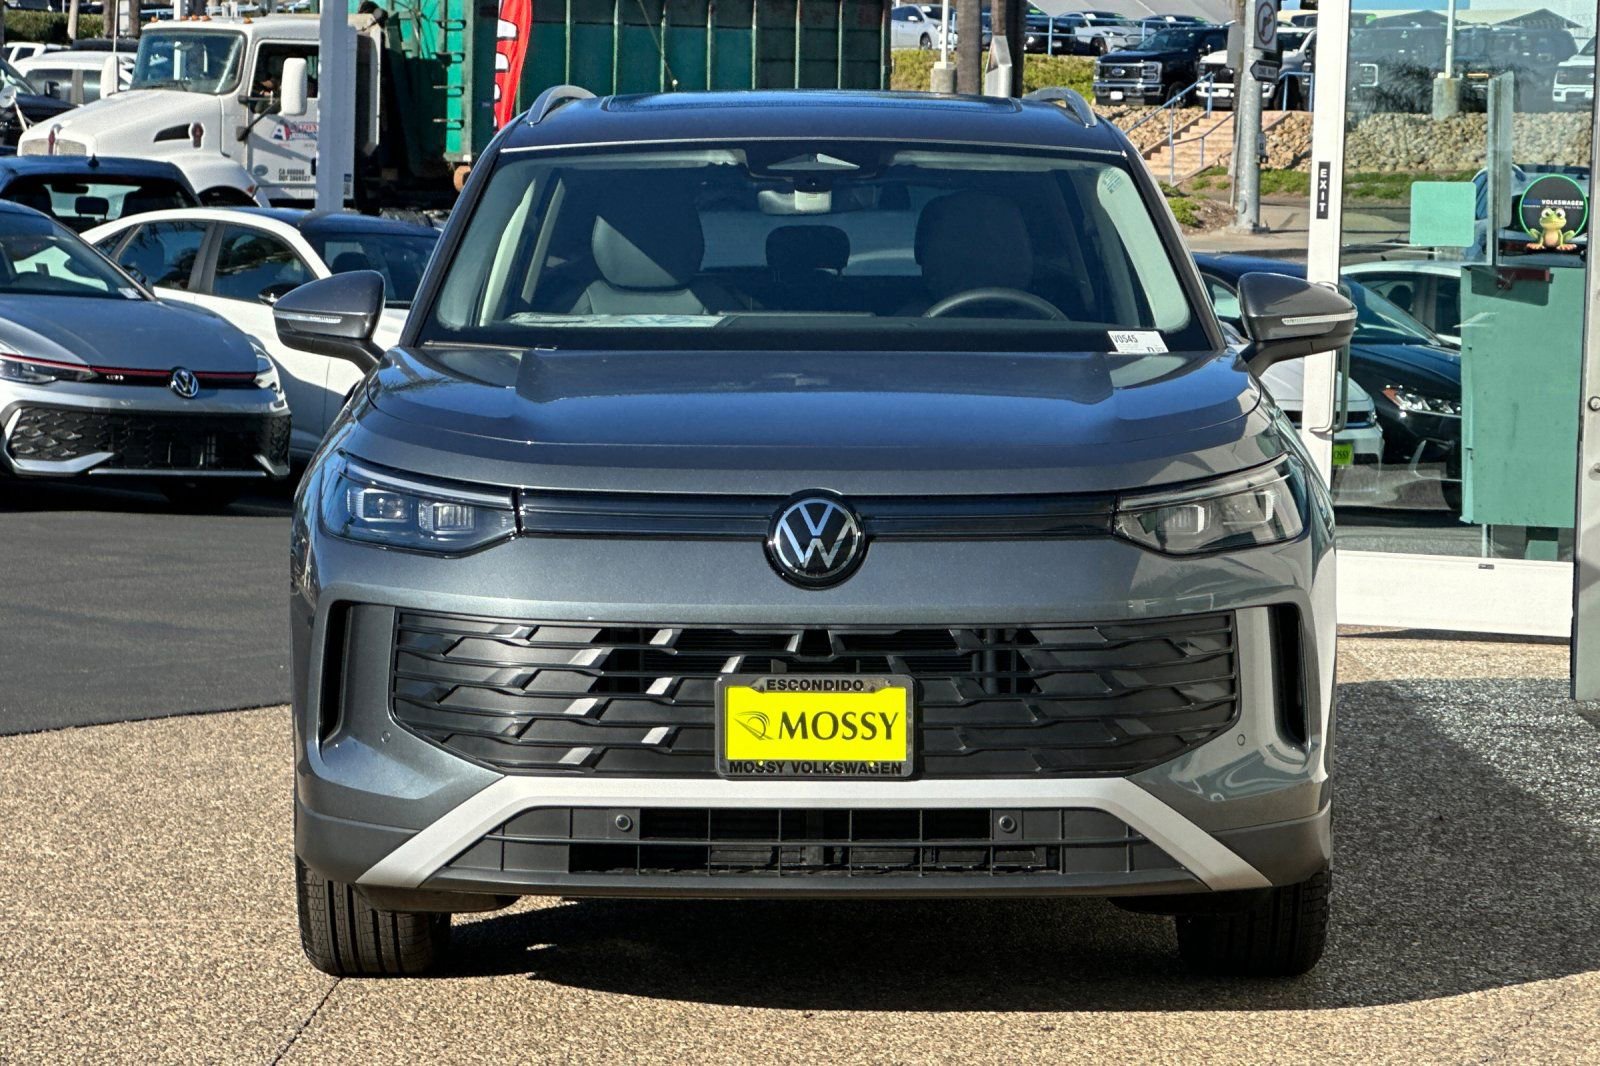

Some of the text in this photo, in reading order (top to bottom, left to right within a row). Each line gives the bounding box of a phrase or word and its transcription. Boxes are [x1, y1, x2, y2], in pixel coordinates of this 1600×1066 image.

[1319, 168, 1328, 212] EXIT
[1111, 334, 1139, 344] V0545
[1333, 449, 1350, 460] OSSY
[766, 679, 864, 692] ESCONDIDO
[778, 711, 899, 741] MOSSY
[729, 761, 902, 775] MOSSY VOLKSWAGEN
